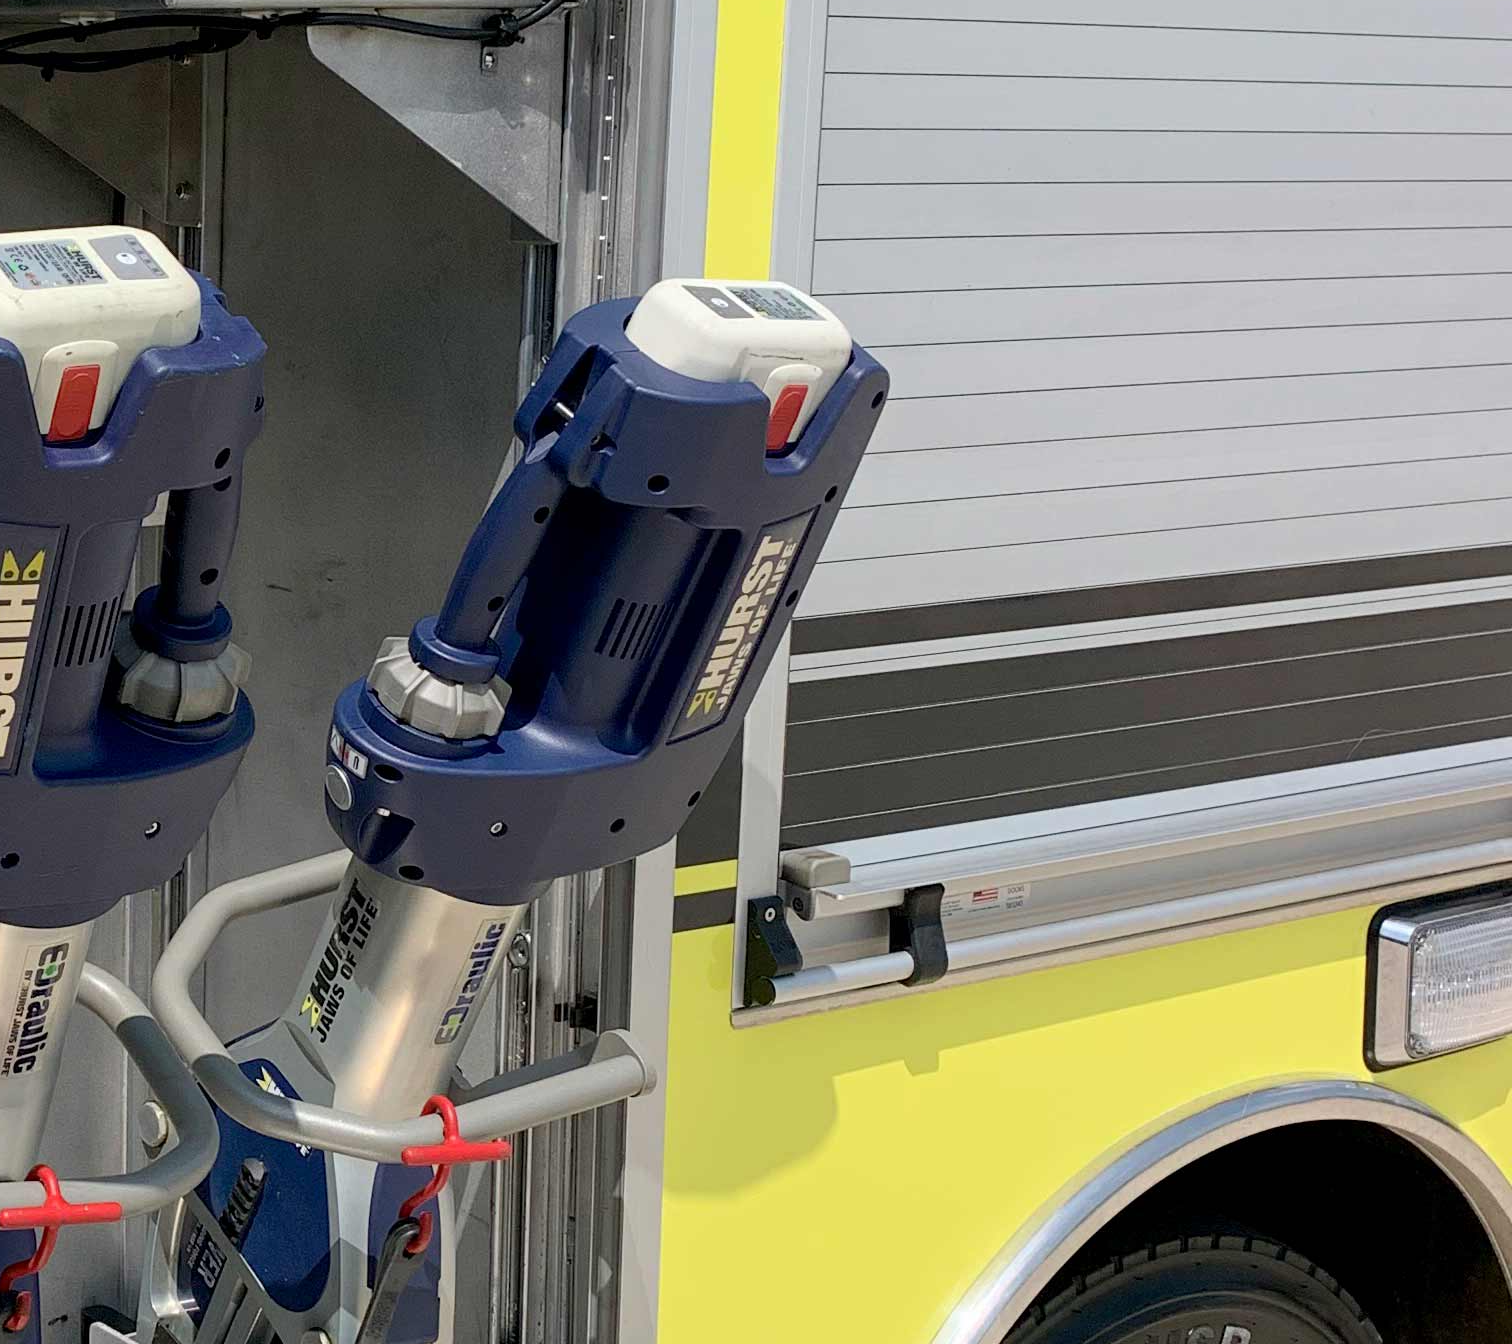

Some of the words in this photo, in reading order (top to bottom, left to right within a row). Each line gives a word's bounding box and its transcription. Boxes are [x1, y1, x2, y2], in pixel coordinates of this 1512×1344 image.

[698, 536, 784, 693] HURST
[717, 641, 752, 711] JAWS
[749, 603, 769, 634] OF
[765, 541, 796, 605] LIFE
[24, 970, 34, 983] BY
[309, 877, 367, 1001] HURST
[318, 986, 345, 1043] JAWS
[339, 950, 358, 981] OF
[353, 901, 378, 949] LIFE
[14, 987, 27, 1018] HURST
[0, 1056, 11, 1077] LIFE
